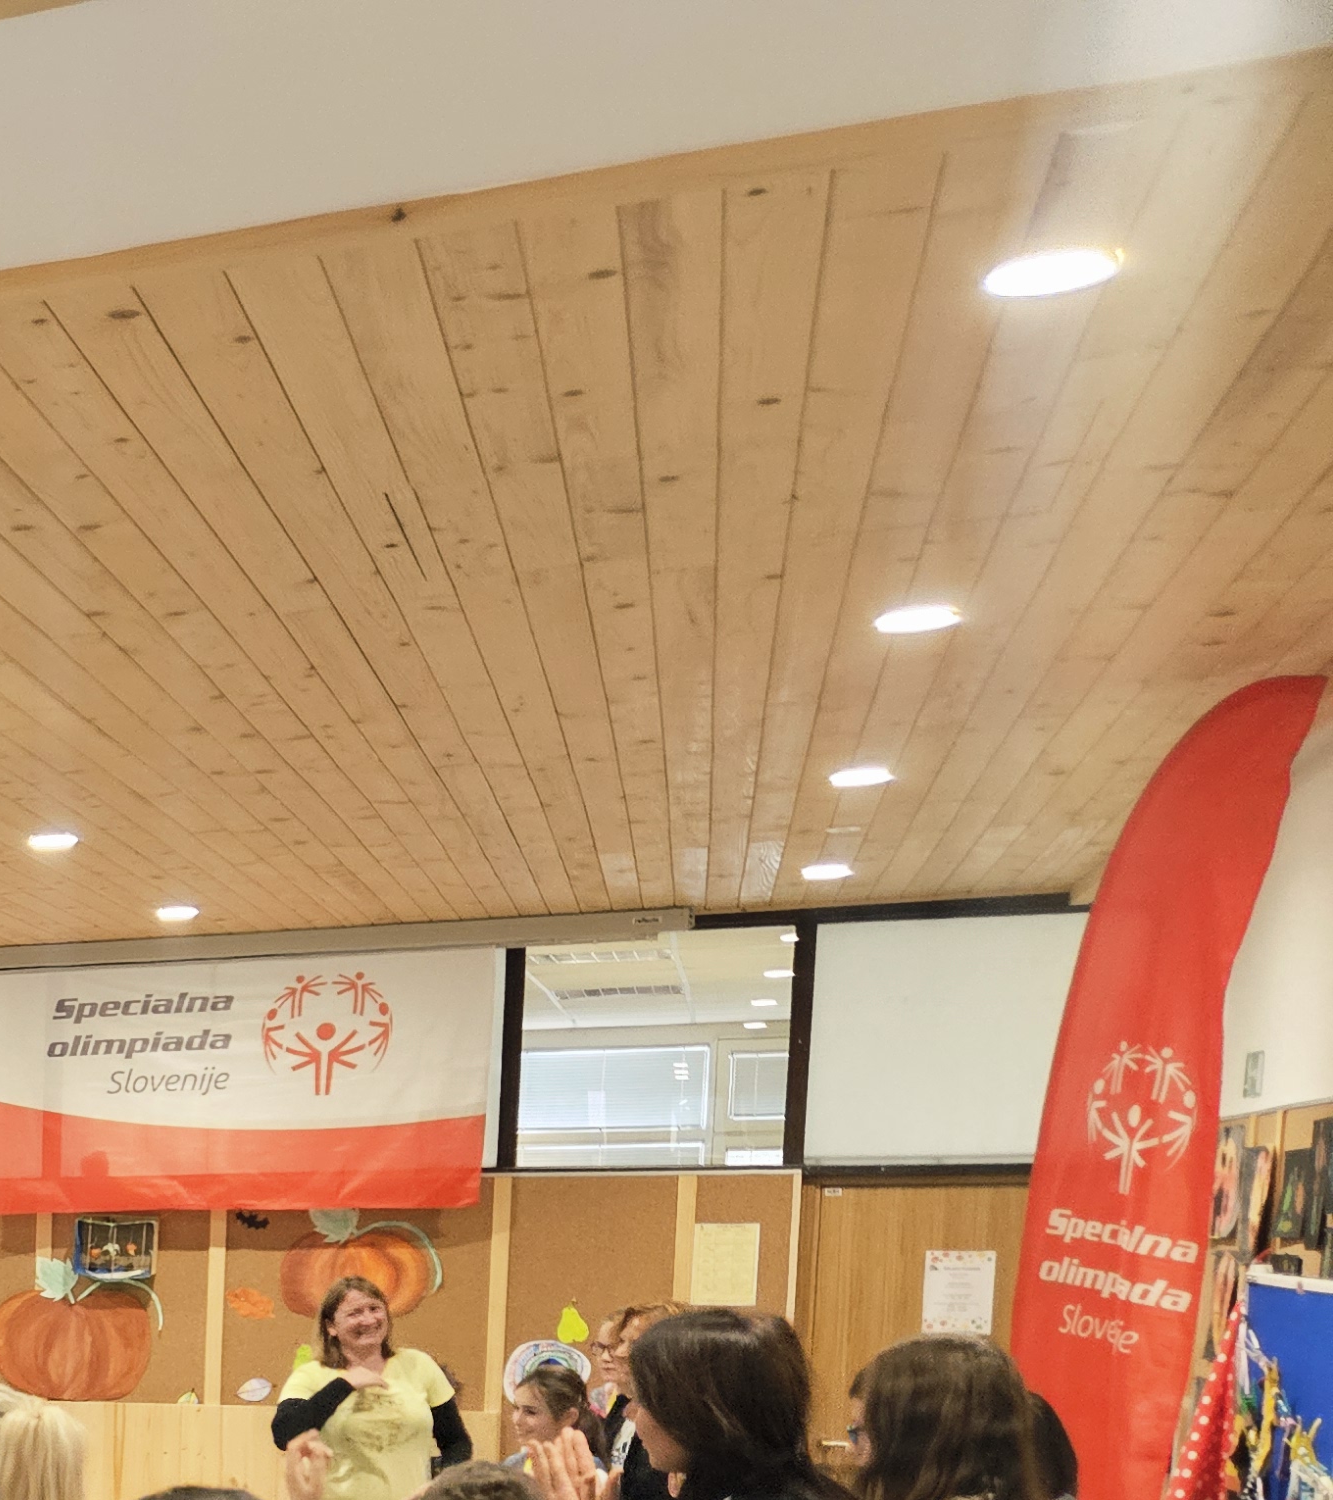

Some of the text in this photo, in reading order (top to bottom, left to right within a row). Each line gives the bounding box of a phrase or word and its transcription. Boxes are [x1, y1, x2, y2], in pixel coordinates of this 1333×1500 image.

[52, 992, 235, 1024] Specialna
[46, 1029, 233, 1060] olimpiada
[106, 1066, 231, 1096] Slovenije
[1039, 1256, 1193, 1313] olimpada
